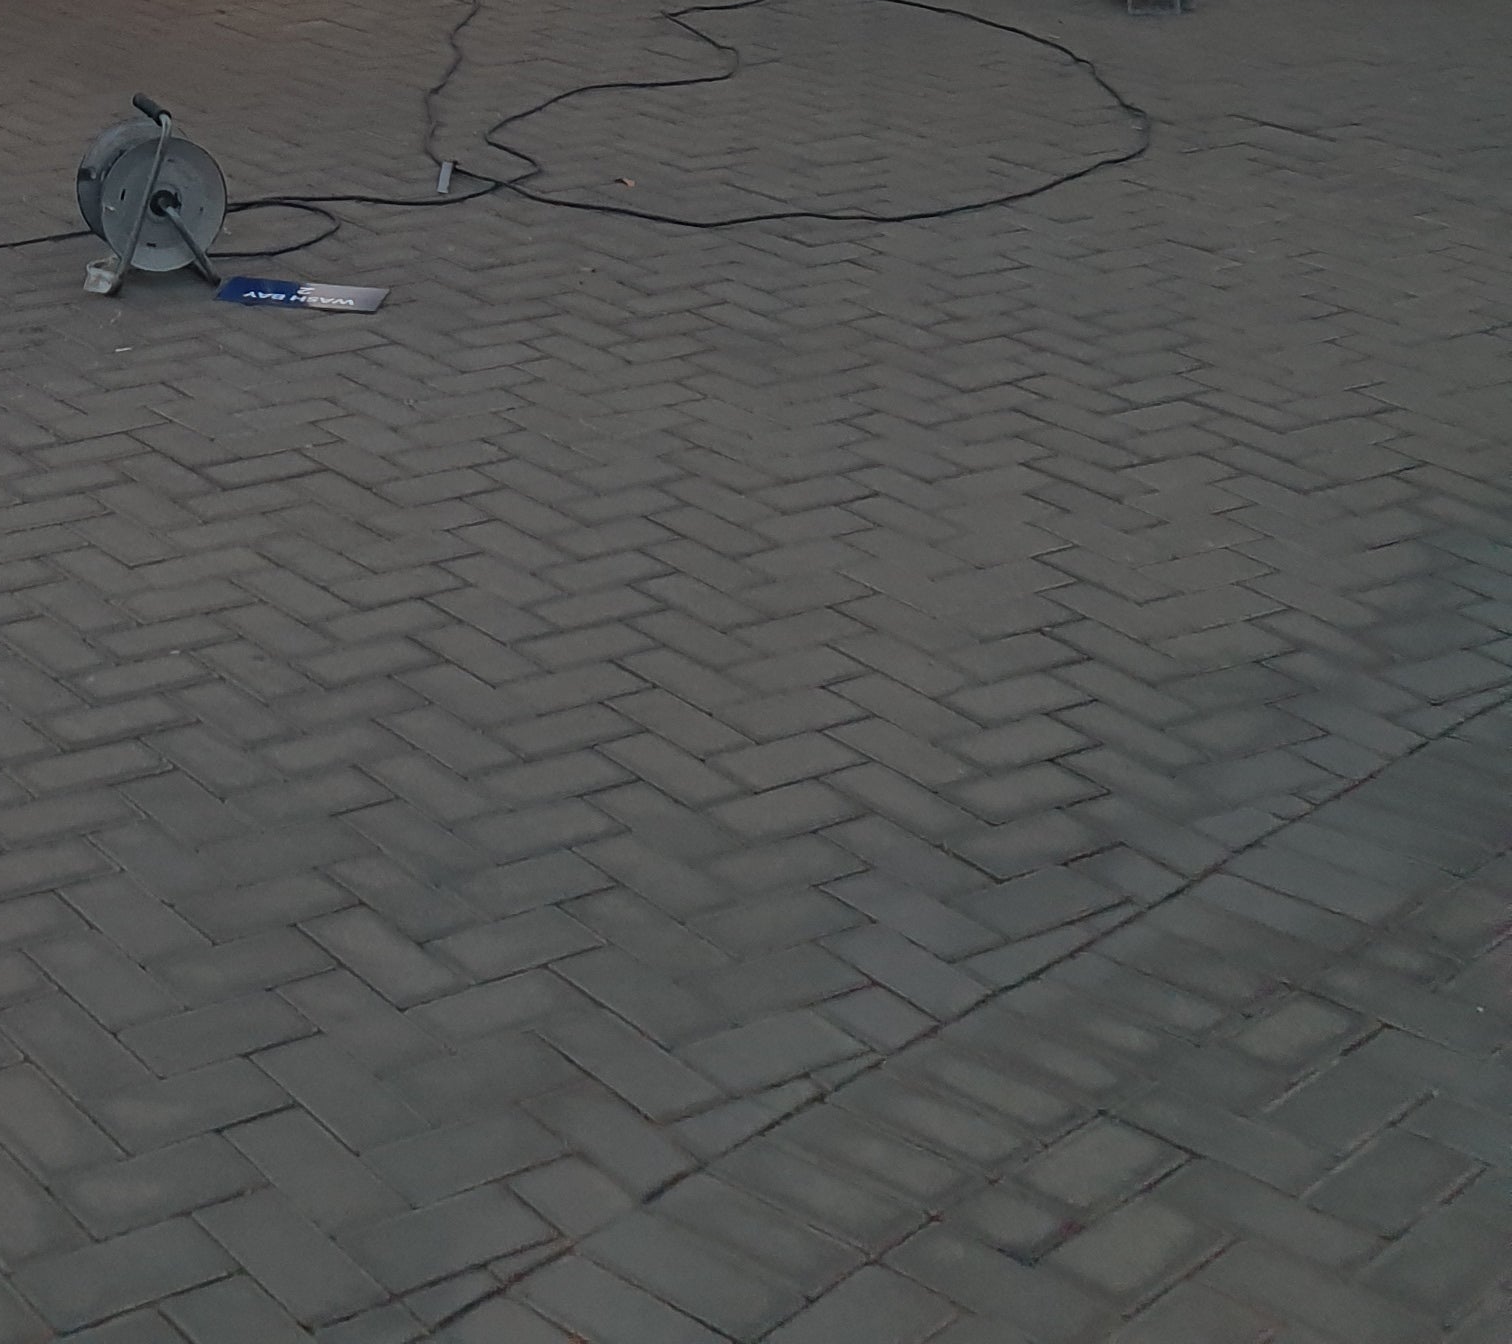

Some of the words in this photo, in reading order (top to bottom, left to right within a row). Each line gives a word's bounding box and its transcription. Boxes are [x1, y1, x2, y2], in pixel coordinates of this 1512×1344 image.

[296, 286, 316, 295] 2
[242, 291, 287, 301] BAY
[289, 293, 355, 306] WASH
